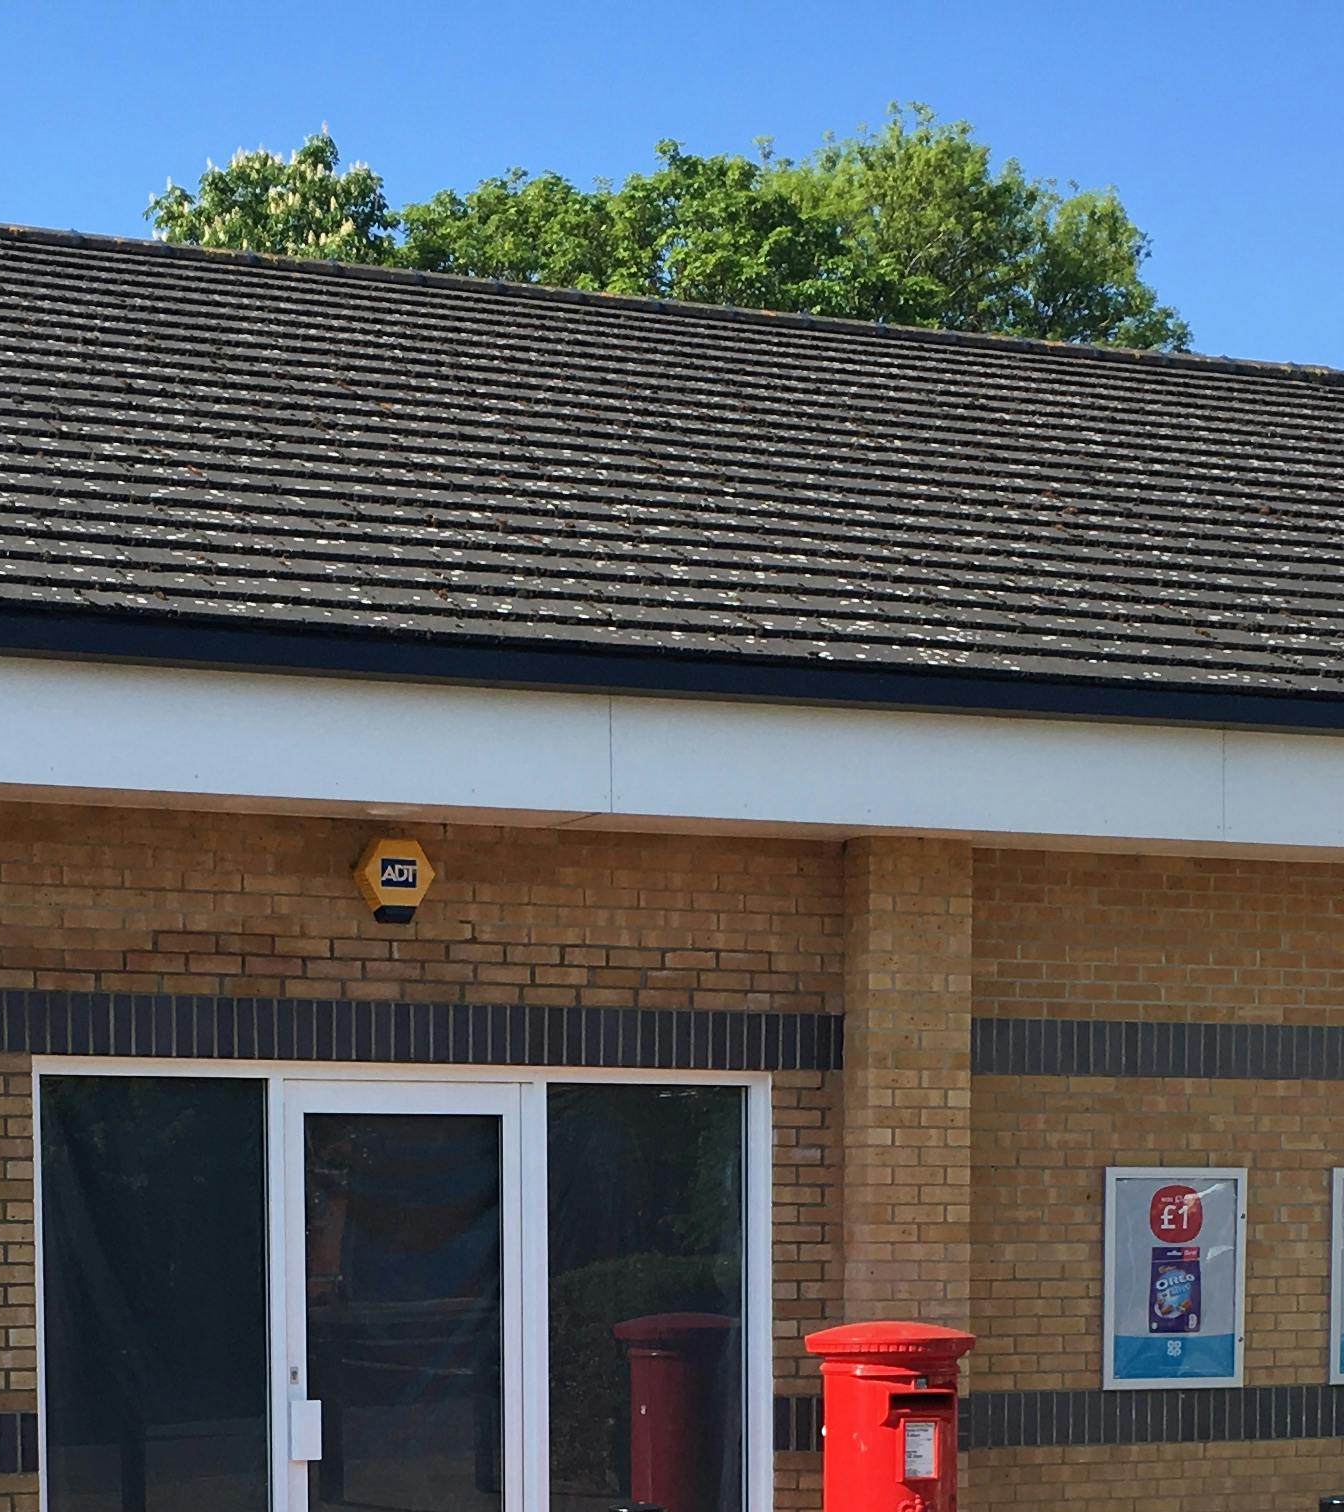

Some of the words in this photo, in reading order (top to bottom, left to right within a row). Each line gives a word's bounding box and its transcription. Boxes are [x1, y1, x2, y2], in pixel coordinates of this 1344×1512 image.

[381, 864, 417, 882] ADT
[1160, 1204, 1190, 1230] £1
[1156, 1273, 1196, 1291] OREO
